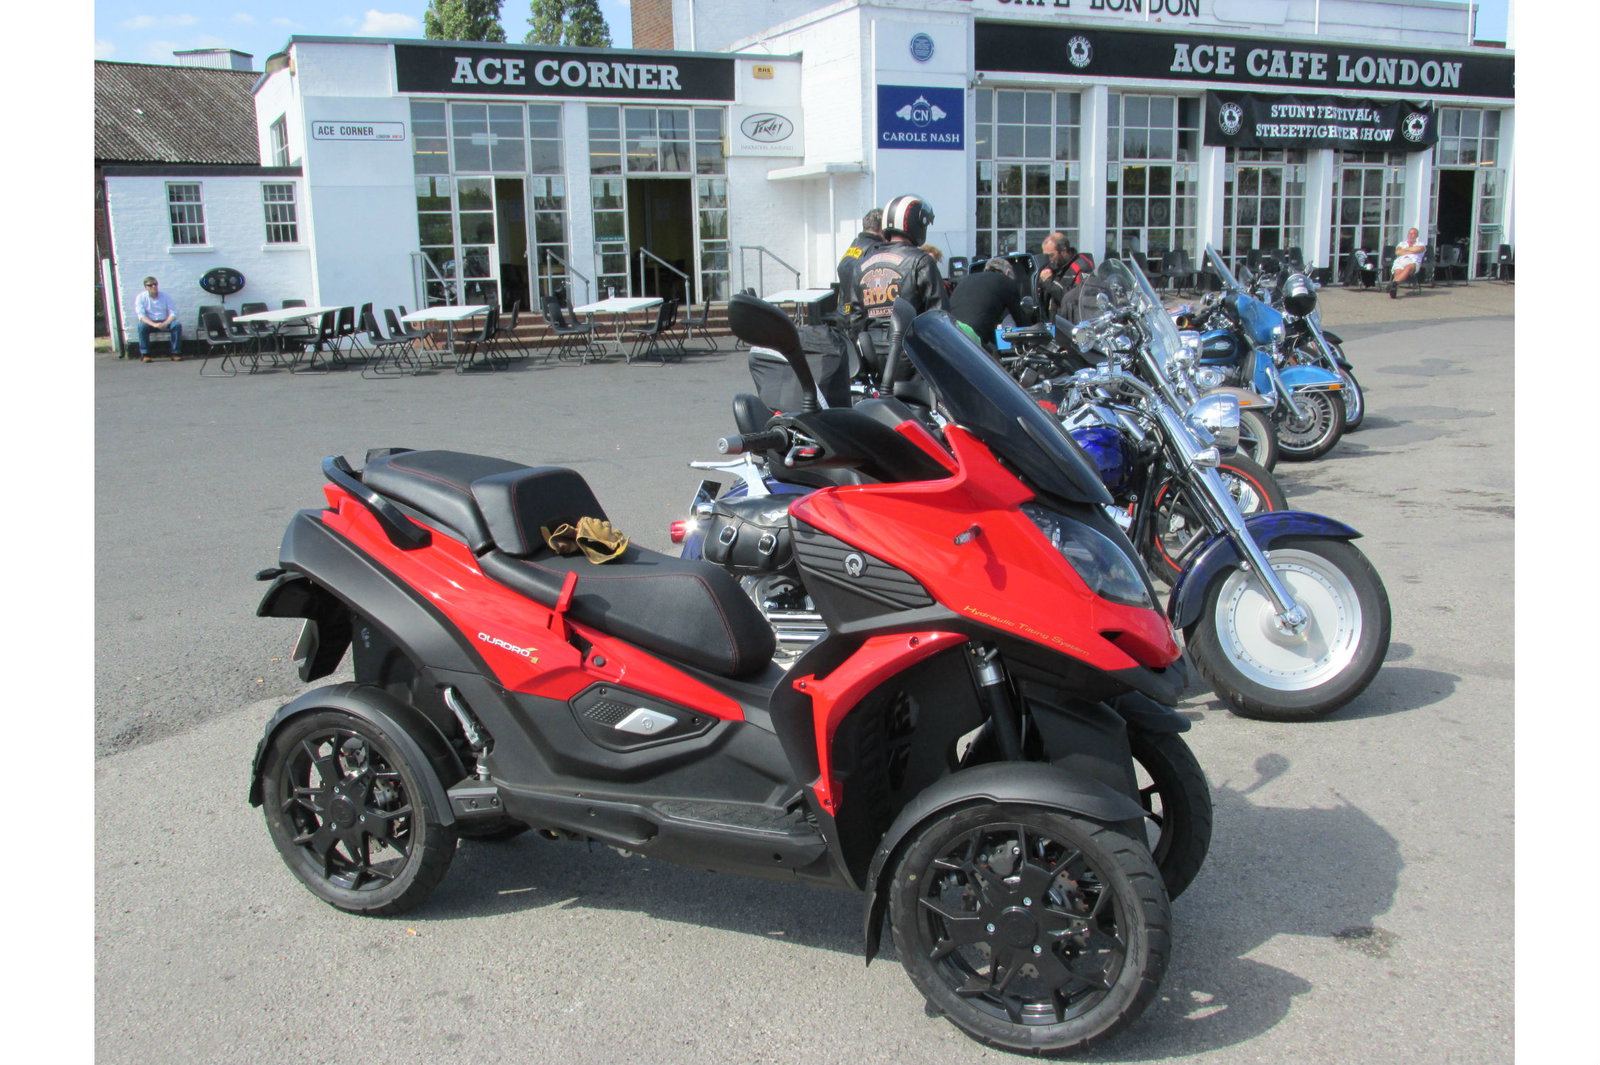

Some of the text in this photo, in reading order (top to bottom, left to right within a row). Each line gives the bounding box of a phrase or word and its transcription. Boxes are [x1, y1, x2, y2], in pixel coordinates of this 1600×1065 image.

[451, 56, 682, 91] ACE CORNER
[1170, 43, 1462, 88] ACE CAFE LONDON
[912, 109, 929, 121] CN
[1271, 104, 1380, 123] STUNT FESTIVAL &
[318, 126, 374, 136] ACE CORNER
[882, 132, 960, 143] CAROLE NASH
[1255, 123, 1394, 142] STREETFIGHTER SHOW
[963, 604, 1016, 627] Hydraulic
[1051, 635, 1091, 657] System
[477, 632, 530, 658] QUADRO
